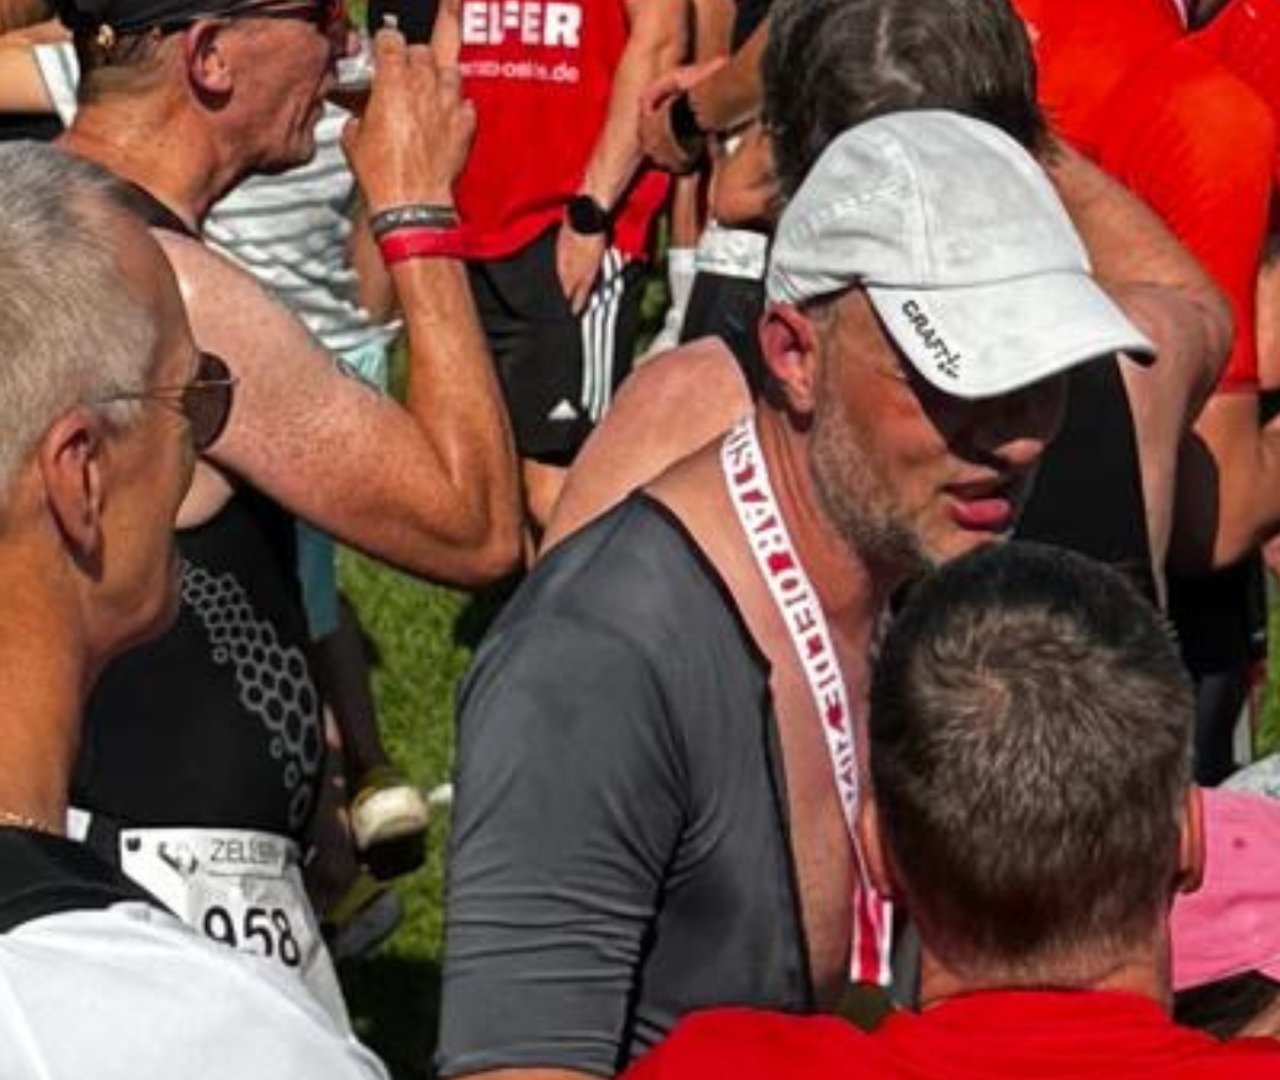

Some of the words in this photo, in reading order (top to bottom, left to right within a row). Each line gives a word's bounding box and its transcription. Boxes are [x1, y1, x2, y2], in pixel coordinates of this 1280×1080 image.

[463, 0, 583, 48] ELFER
[902, 300, 950, 361] CRAFT
[204, 906, 302, 968] 958
